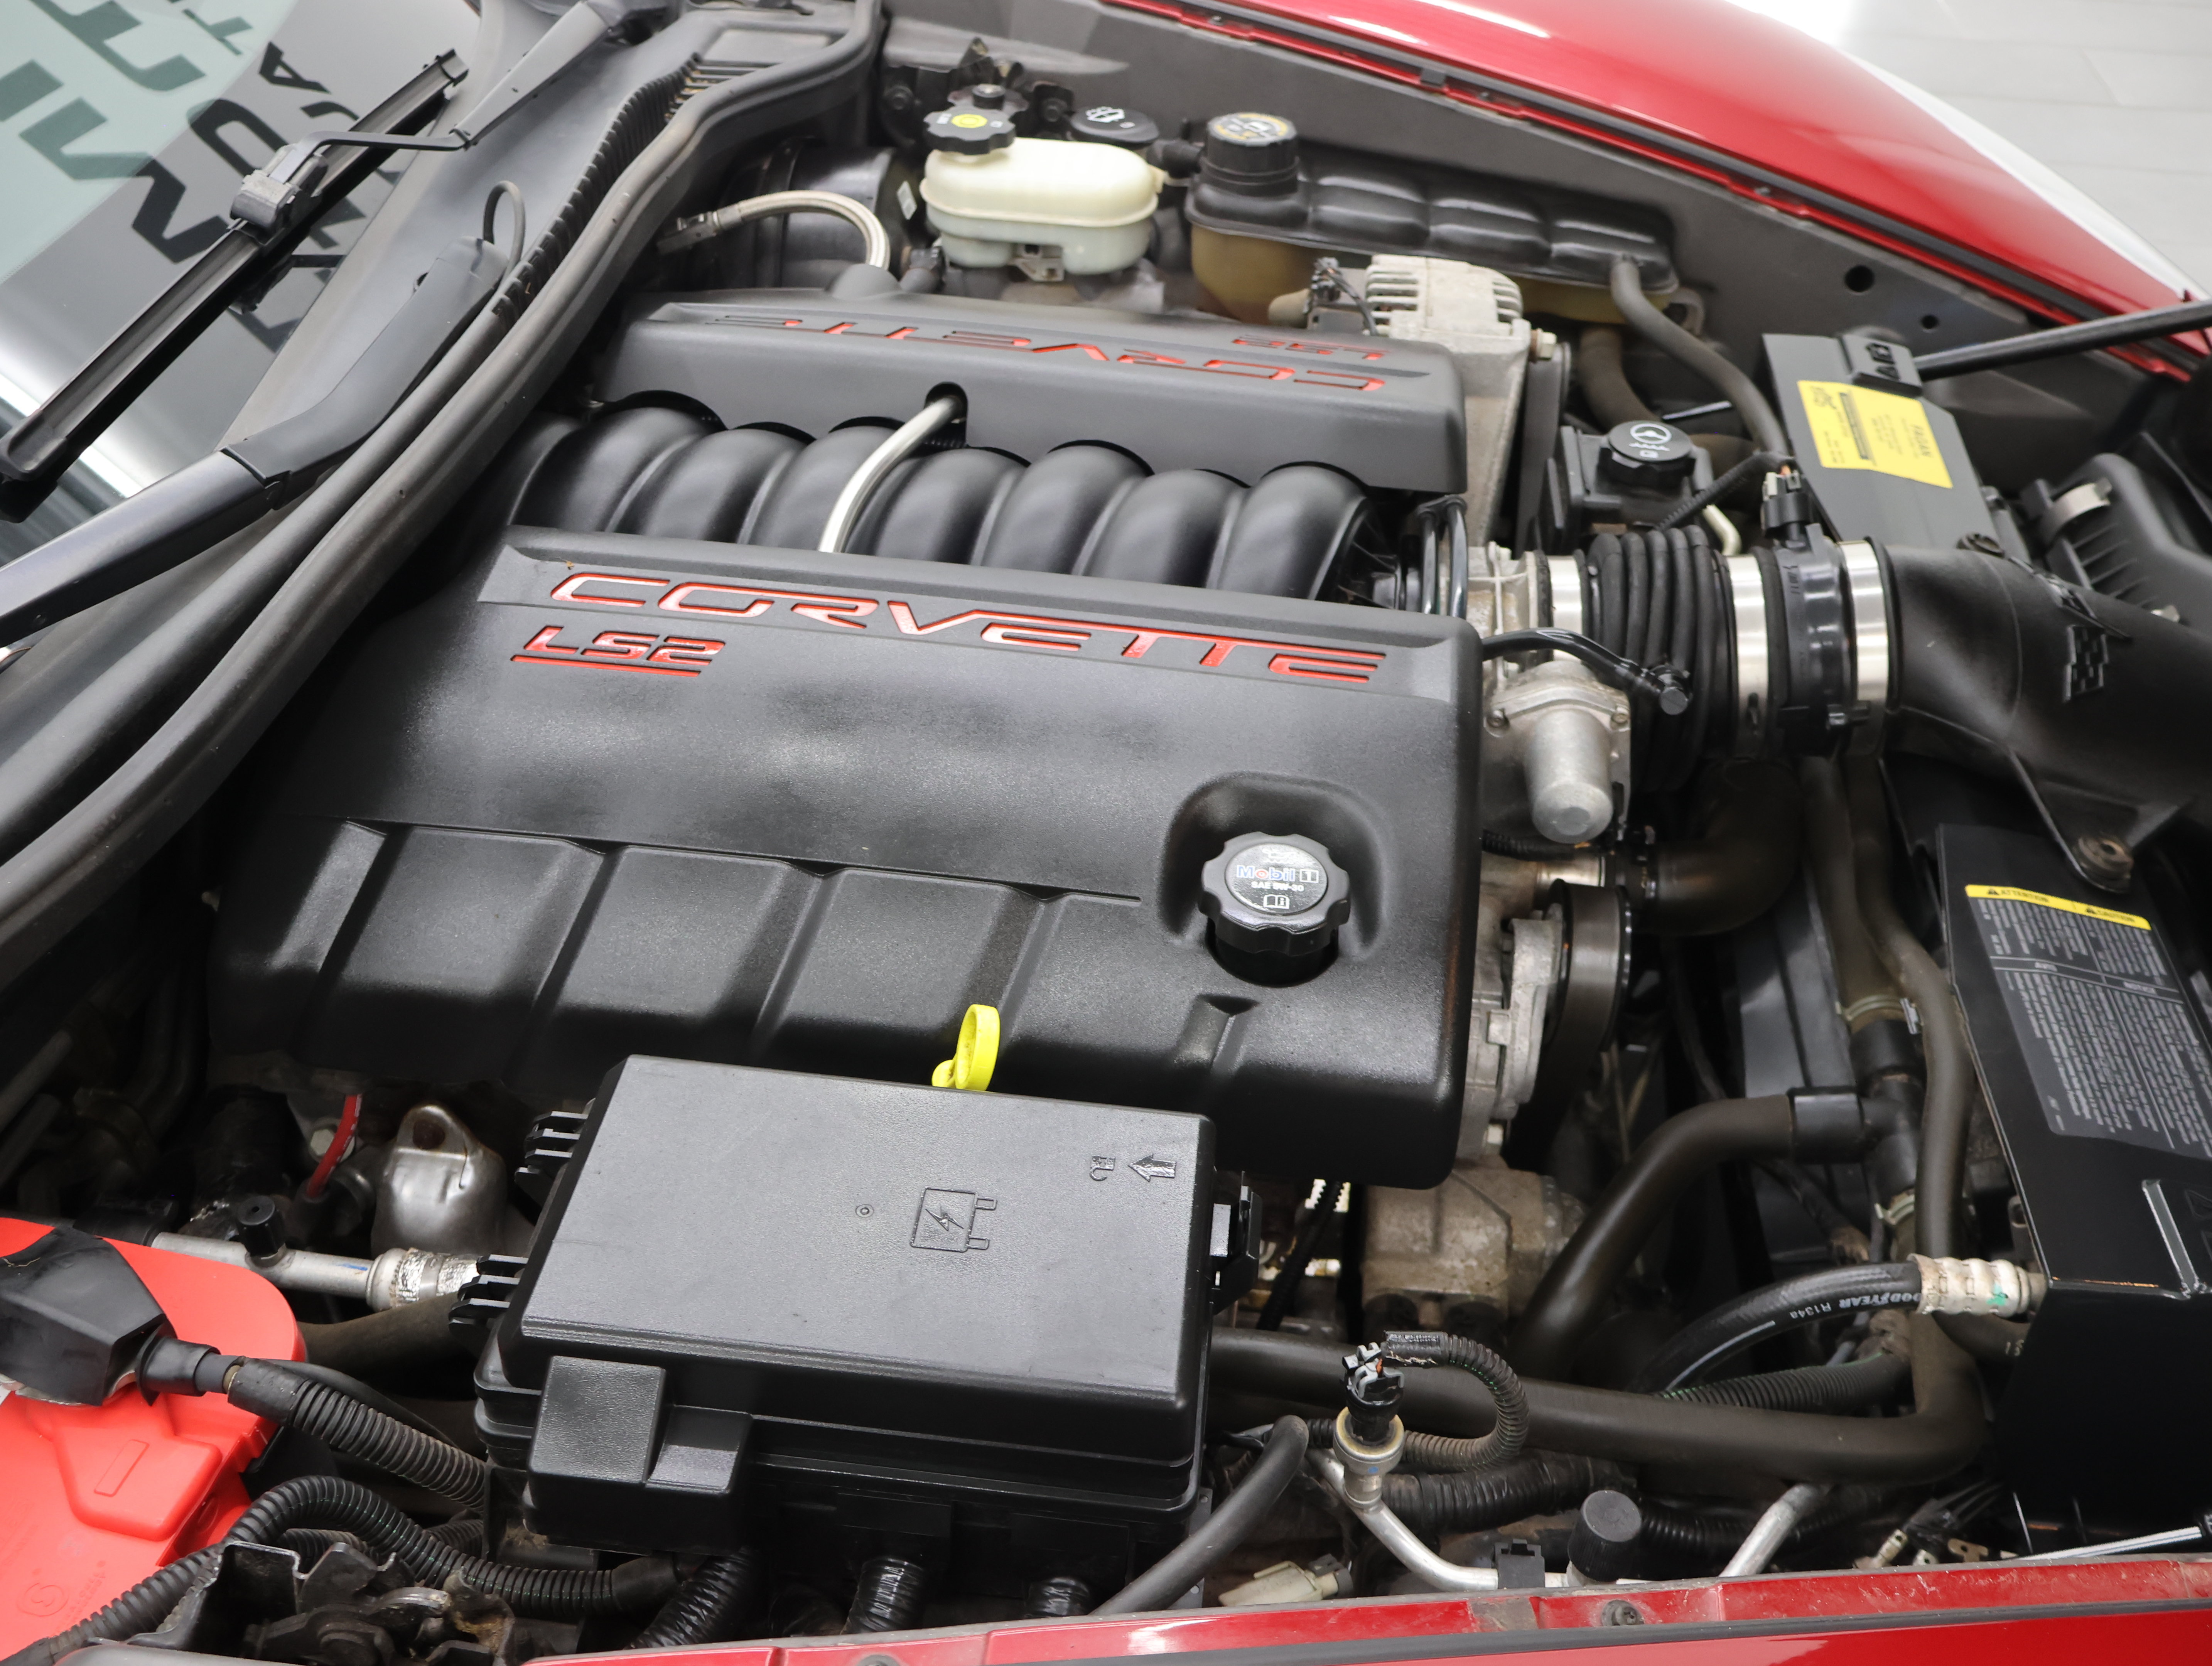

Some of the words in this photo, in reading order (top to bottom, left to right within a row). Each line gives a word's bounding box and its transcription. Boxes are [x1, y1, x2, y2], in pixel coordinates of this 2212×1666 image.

[705, 315, 1386, 391] CORVETTE
[550, 572, 1387, 684] CORVETTE
[523, 624, 726, 667] LS2
[1236, 865, 1296, 882] Mobil
[1251, 881, 1272, 889] SAE
[1839, 1292, 1921, 1309] OODYEAR
[1789, 1302, 1832, 1319] R134a
